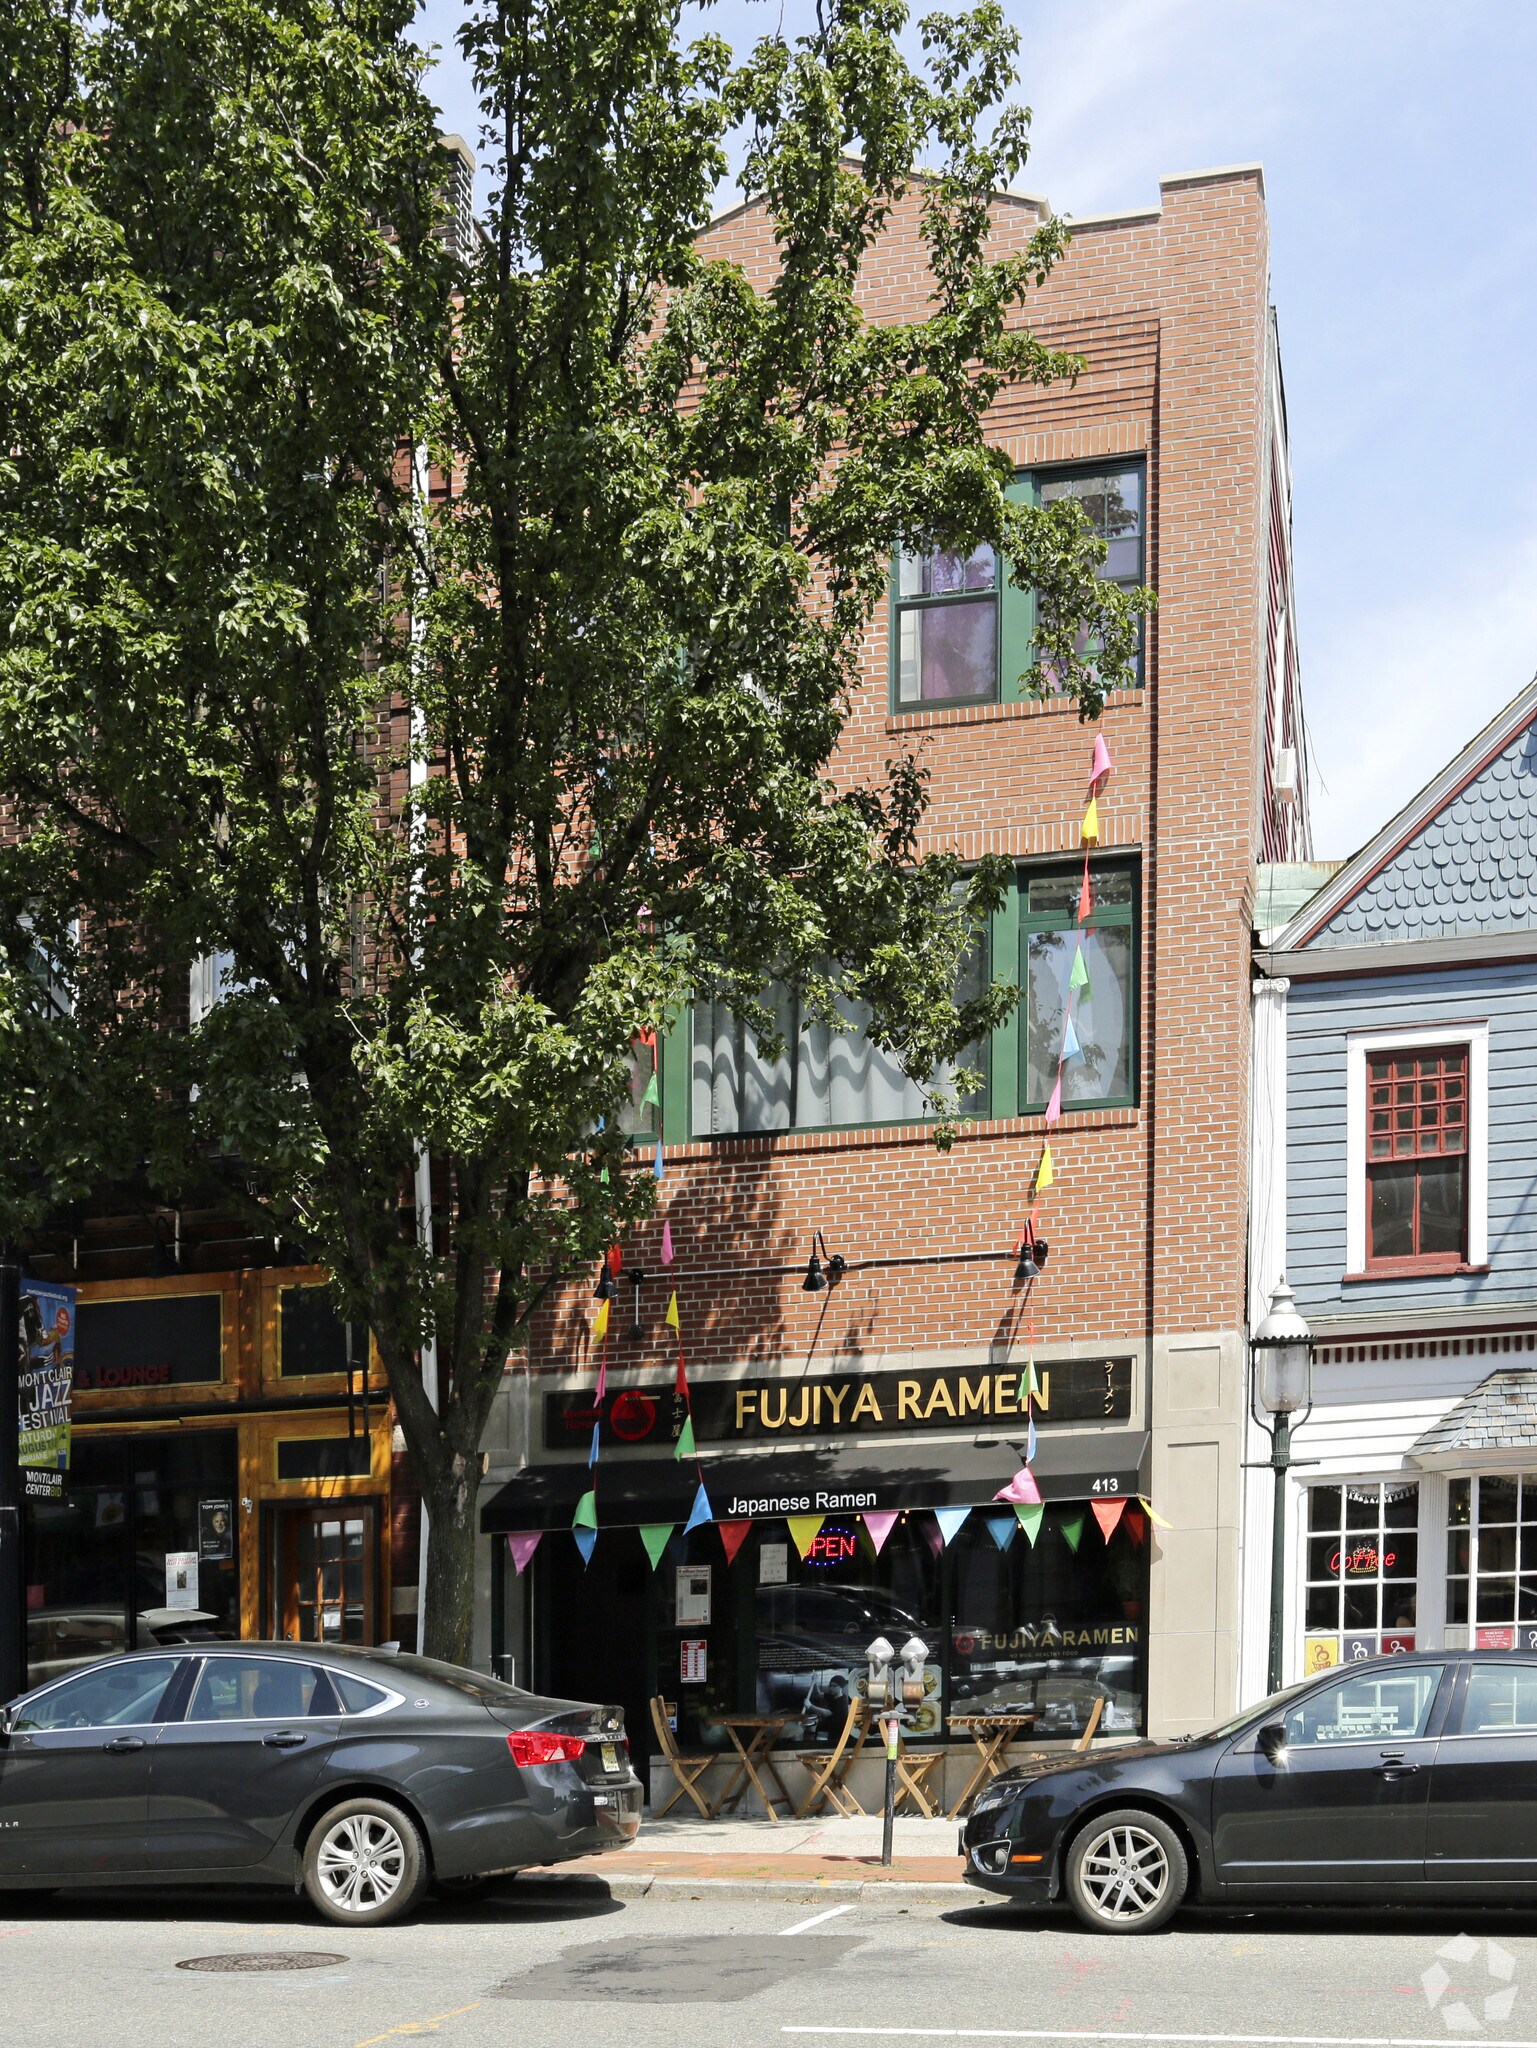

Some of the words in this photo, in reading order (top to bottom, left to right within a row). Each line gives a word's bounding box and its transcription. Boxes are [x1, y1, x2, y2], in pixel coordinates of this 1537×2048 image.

[18, 1366, 73, 1388] MONTCLAIR
[96, 1363, 169, 1387] LOUNGE
[29, 1379, 73, 1412] JAZZ
[1103, 1360, 1113, 1415] ラーメン
[736, 1382, 883, 1429] FUJIYA
[897, 1371, 1049, 1420] RAMEN
[18, 1405, 72, 1431] ESTIVAL
[566, 1419, 596, 1430] Rame
[25, 1470, 63, 1486] MONTCLAIR
[1092, 1478, 1119, 1493] 413
[727, 1497, 810, 1516] Japanese
[816, 1490, 877, 1510] Ramen
[804, 1536, 856, 1557] PEN
[981, 1631, 1055, 1650] FUJIYA
[1062, 1627, 1139, 1646] RAMEN
